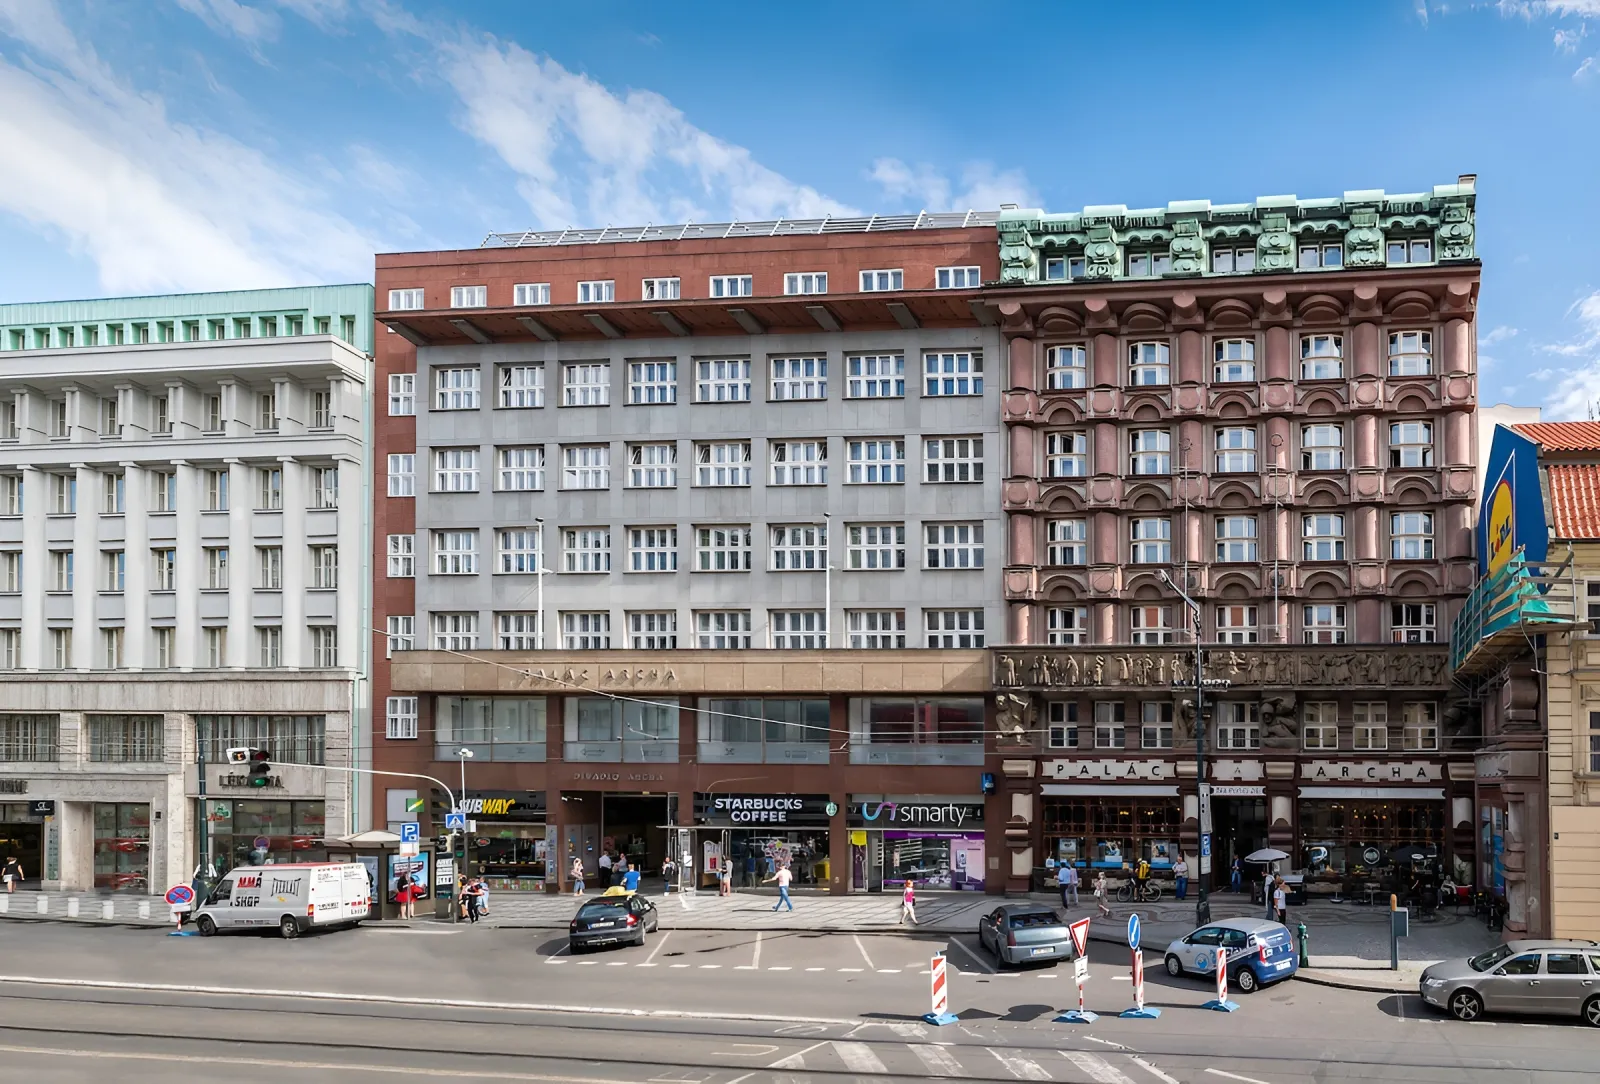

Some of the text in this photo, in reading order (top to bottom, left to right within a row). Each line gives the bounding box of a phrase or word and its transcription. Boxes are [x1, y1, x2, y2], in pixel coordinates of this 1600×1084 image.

[1057, 762, 1160, 776] PALÁC
[1316, 766, 1427, 778] ARCHA
[456, 798, 516, 815] SUBWAY
[714, 798, 803, 809] STARBUCKS
[730, 811, 787, 822] COFFEE
[900, 803, 966, 827] smarty
